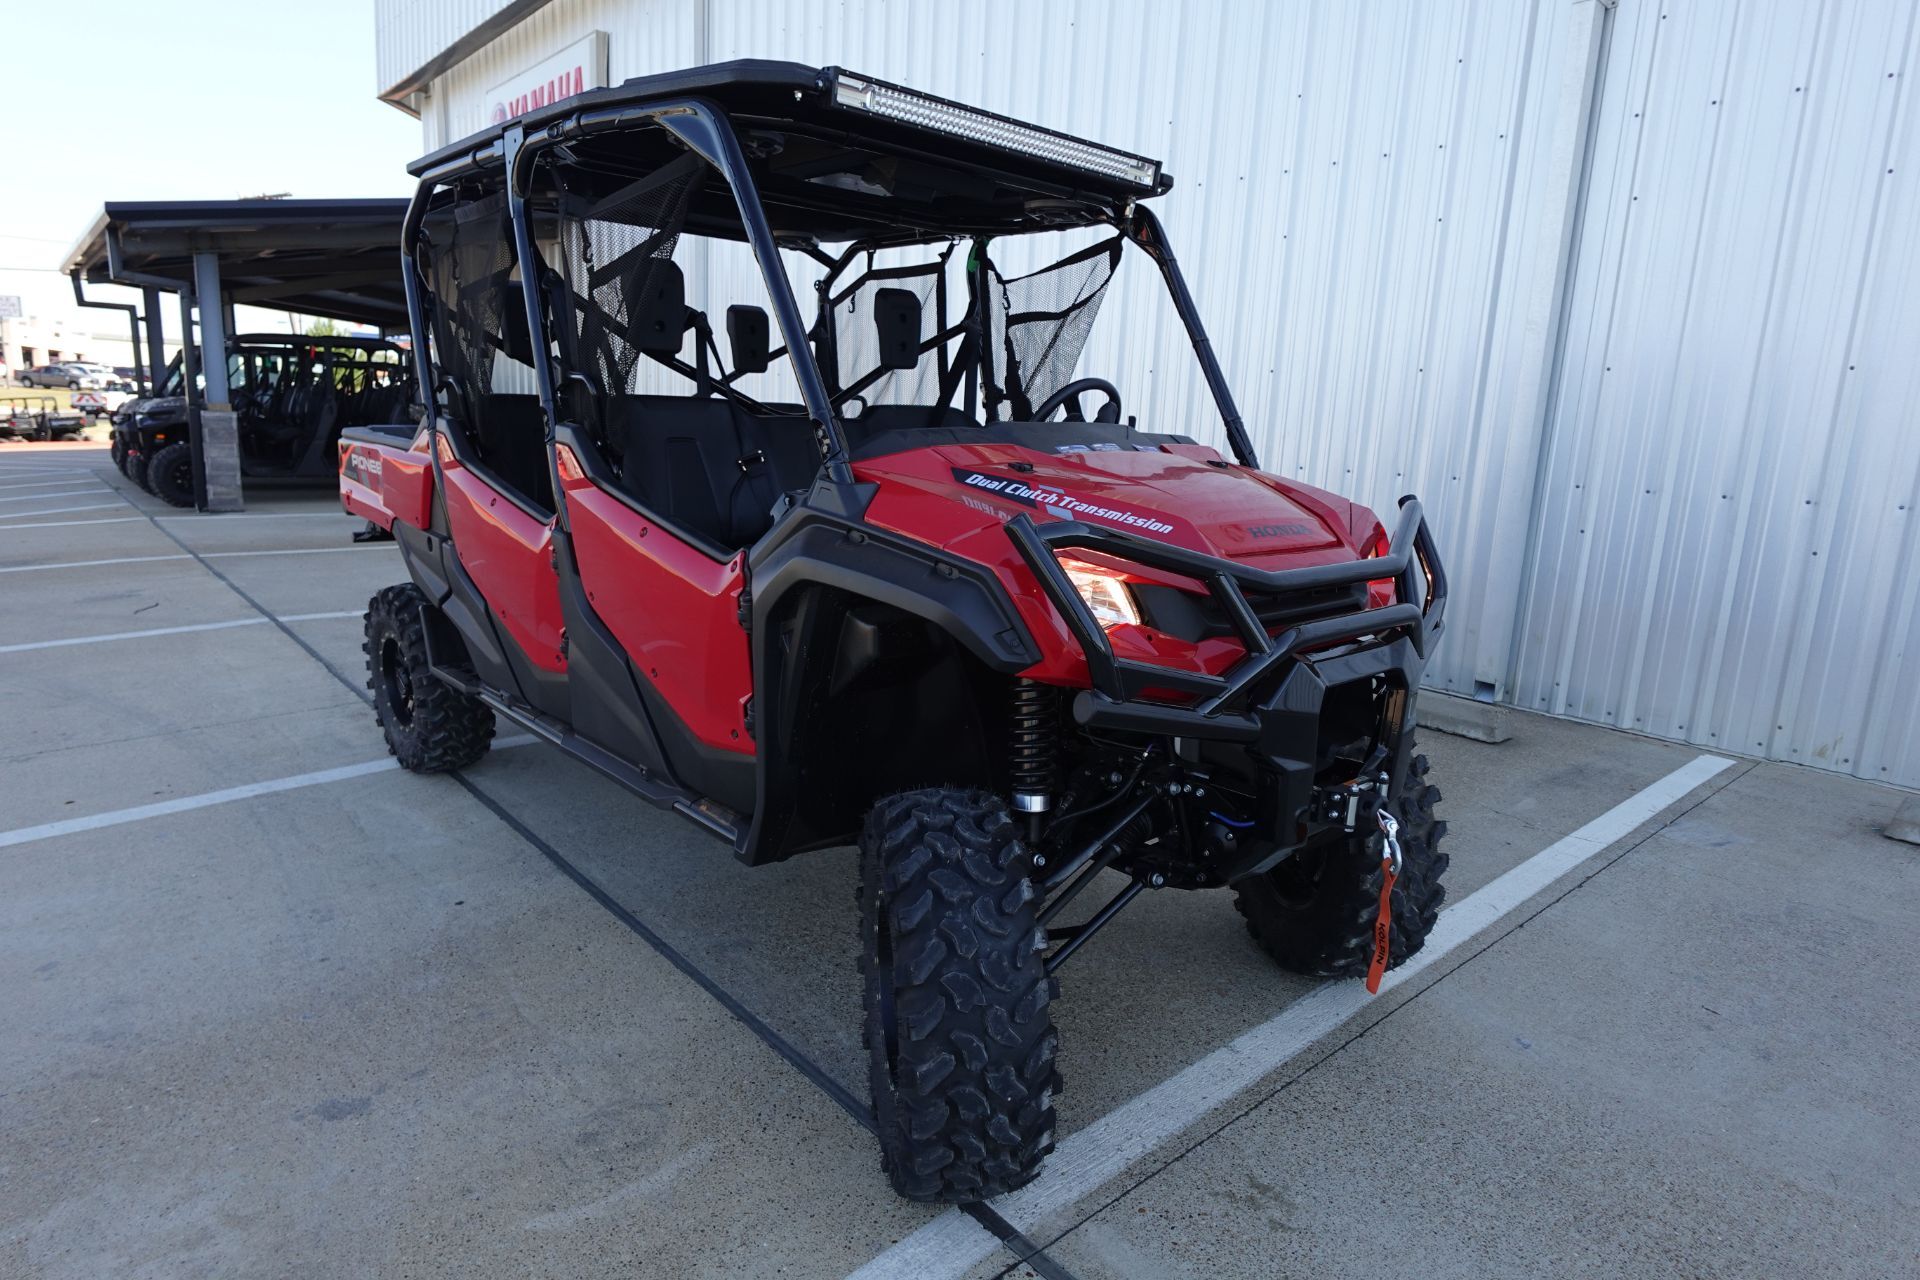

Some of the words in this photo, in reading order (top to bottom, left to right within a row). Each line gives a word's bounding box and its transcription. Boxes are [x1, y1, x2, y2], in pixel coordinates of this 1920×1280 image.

[508, 65, 584, 119] YAMAHA
[351, 453, 382, 475] PIONEE
[964, 473, 1008, 491] Dual
[1004, 483, 1059, 504] Clutch
[1058, 495, 1174, 534] Transmission
[1376, 922, 1386, 965] KOLPIN
